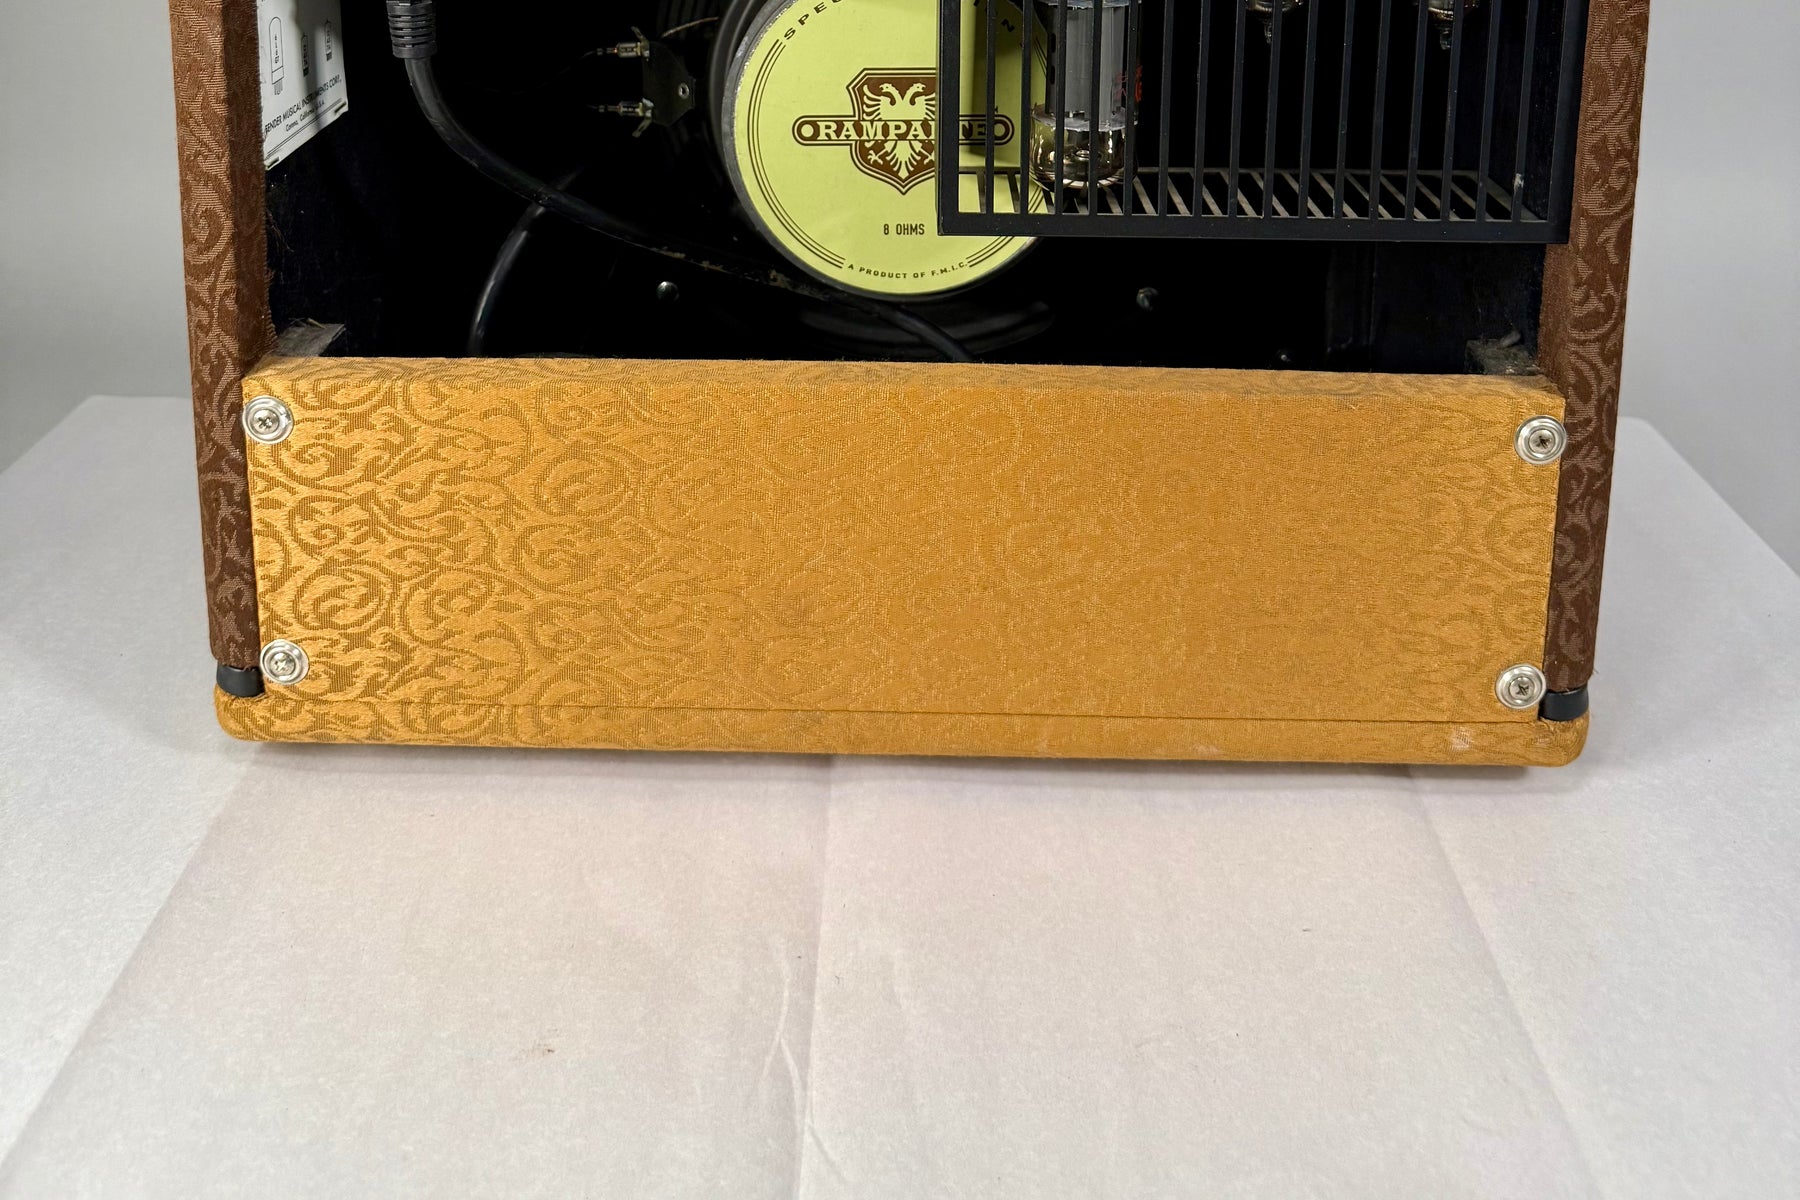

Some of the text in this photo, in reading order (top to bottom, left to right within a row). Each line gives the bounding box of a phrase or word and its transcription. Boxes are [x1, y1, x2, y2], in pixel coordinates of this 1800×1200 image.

[883, 223, 925, 236] 8 OHMS
[858, 266, 908, 279] PRODUCT
[912, 271, 926, 279] OF
